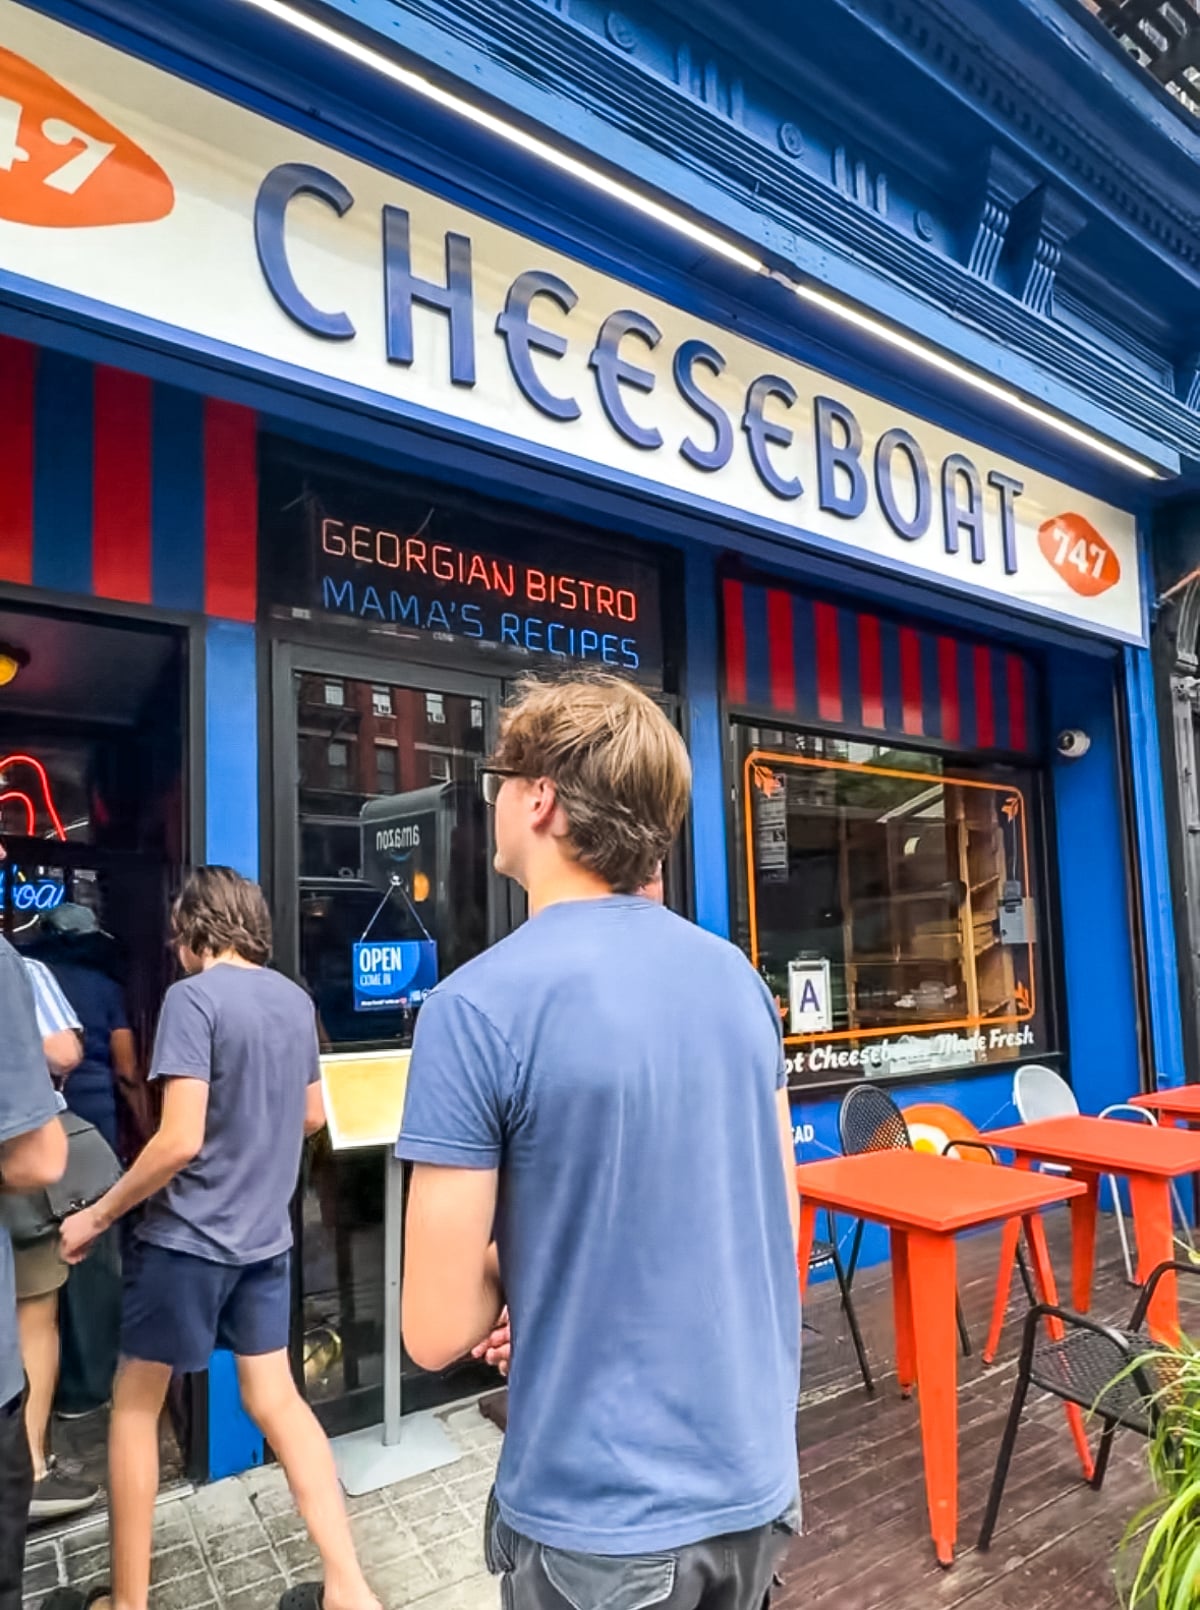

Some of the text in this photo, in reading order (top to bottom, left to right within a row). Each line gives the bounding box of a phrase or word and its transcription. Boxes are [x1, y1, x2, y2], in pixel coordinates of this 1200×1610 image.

[254, 162, 1025, 575] CHEESEBOAT
[321, 517, 637, 622] GEORGIAN BISTRO
[1052, 527, 1107, 579] 747
[321, 575, 640, 669] MAMA'S RECIPES
[360, 946, 402, 972] OPEN
[360, 973, 381, 986] COME
[800, 979, 820, 1013] A
[783, 1052, 805, 1074] ot
[809, 1037, 927, 1071] Cheeseb
[989, 1025, 1034, 1050] Fresh
